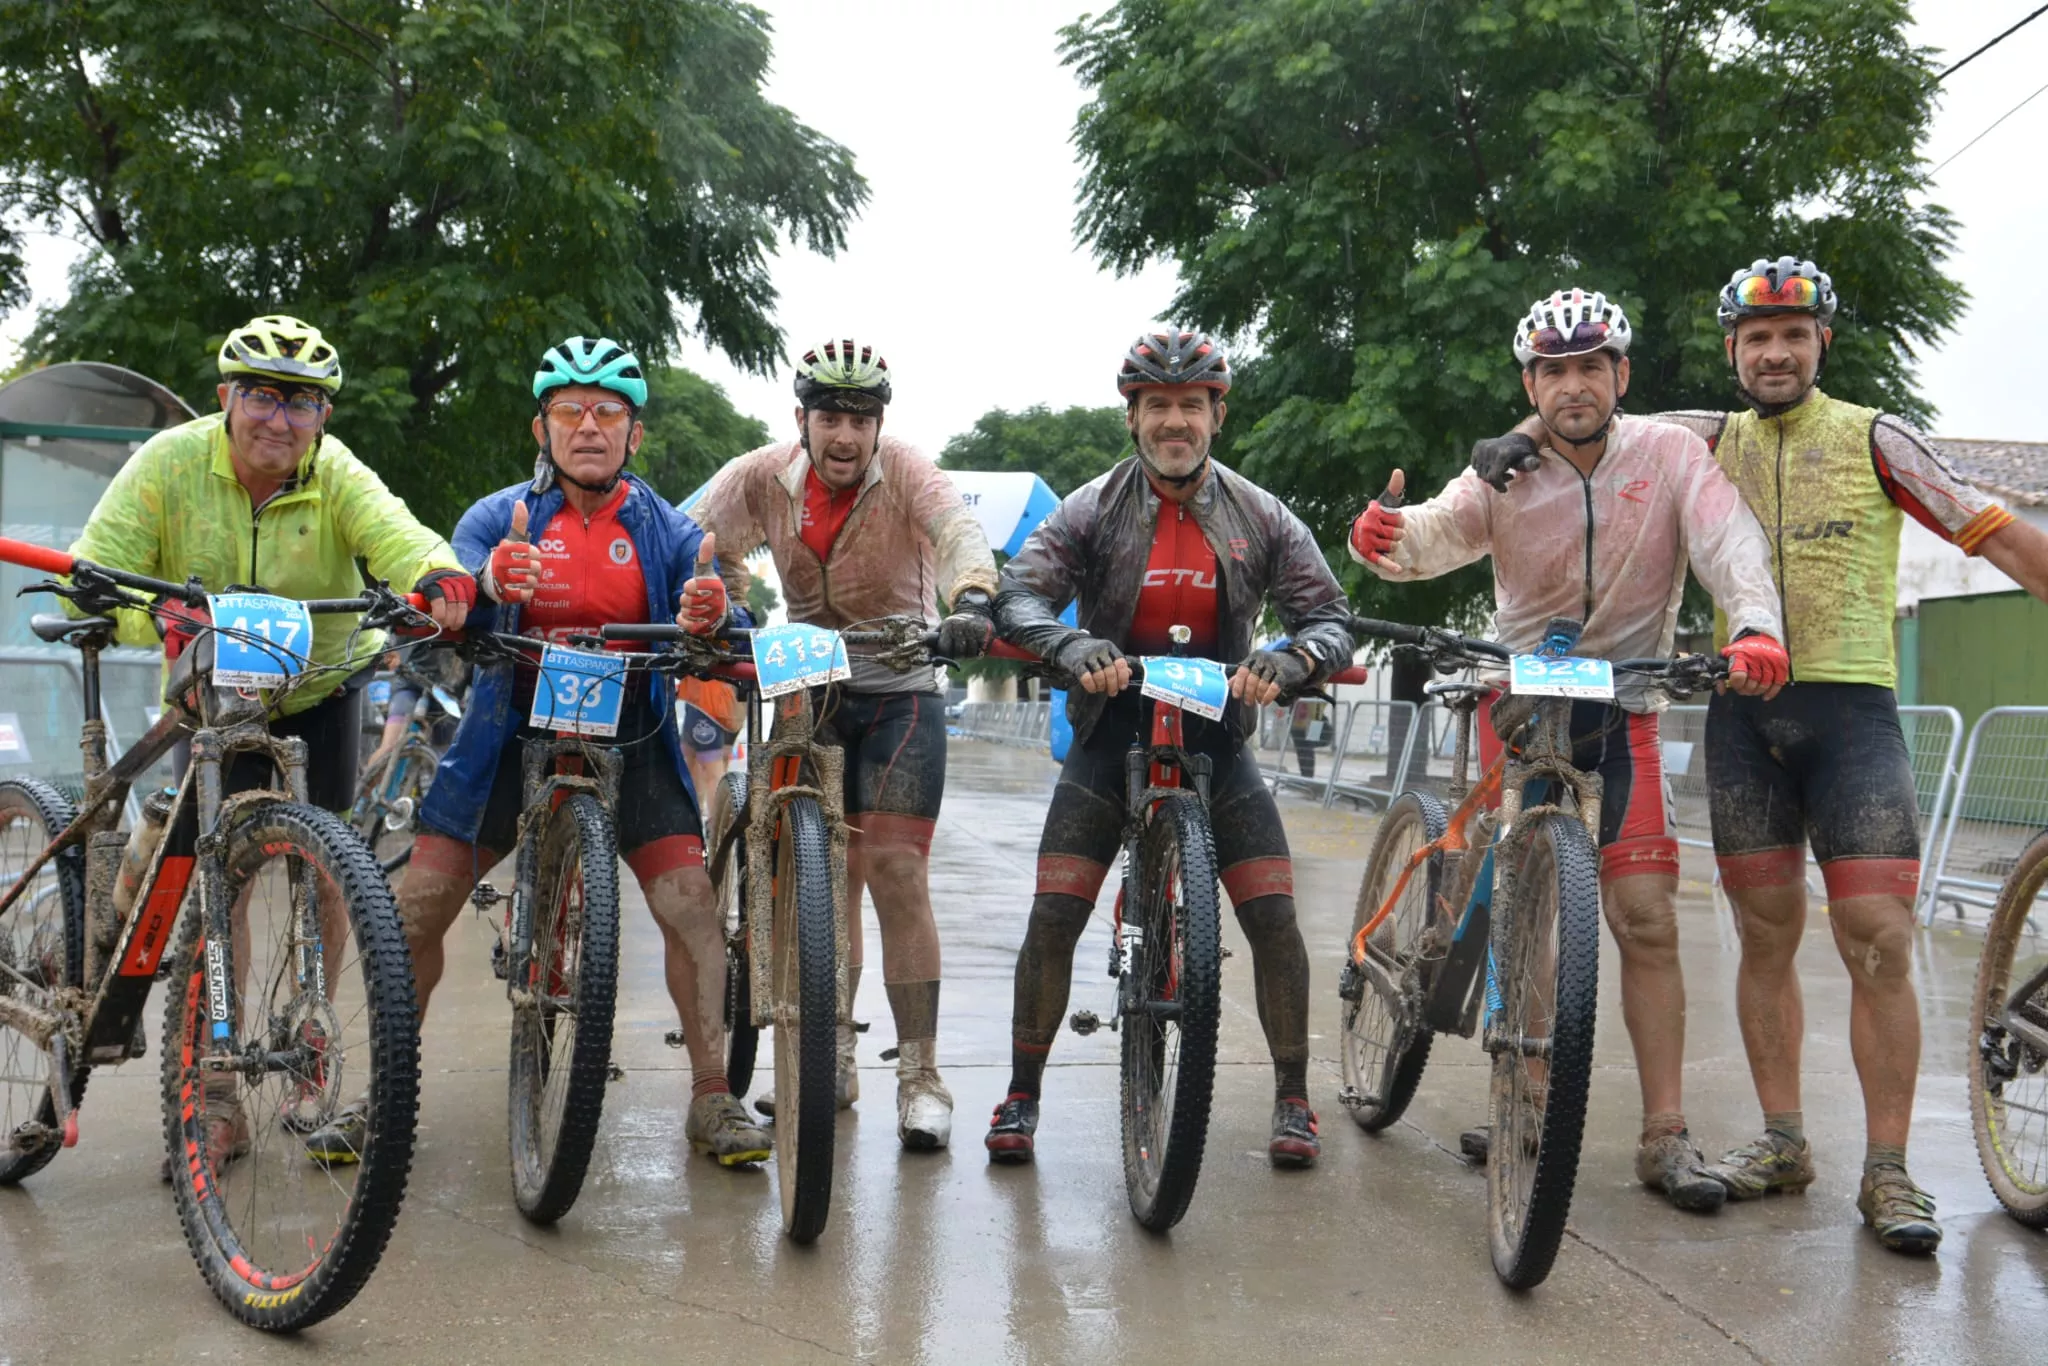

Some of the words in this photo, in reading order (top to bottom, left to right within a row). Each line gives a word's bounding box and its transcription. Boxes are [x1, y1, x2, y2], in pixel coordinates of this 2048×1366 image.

[533, 598, 570, 609] Terralit
[226, 616, 300, 656] 417
[765, 634, 833, 667] 415
[1164, 662, 1204, 687] 31
[1523, 660, 1602, 676] 324
[557, 674, 603, 708] 33
